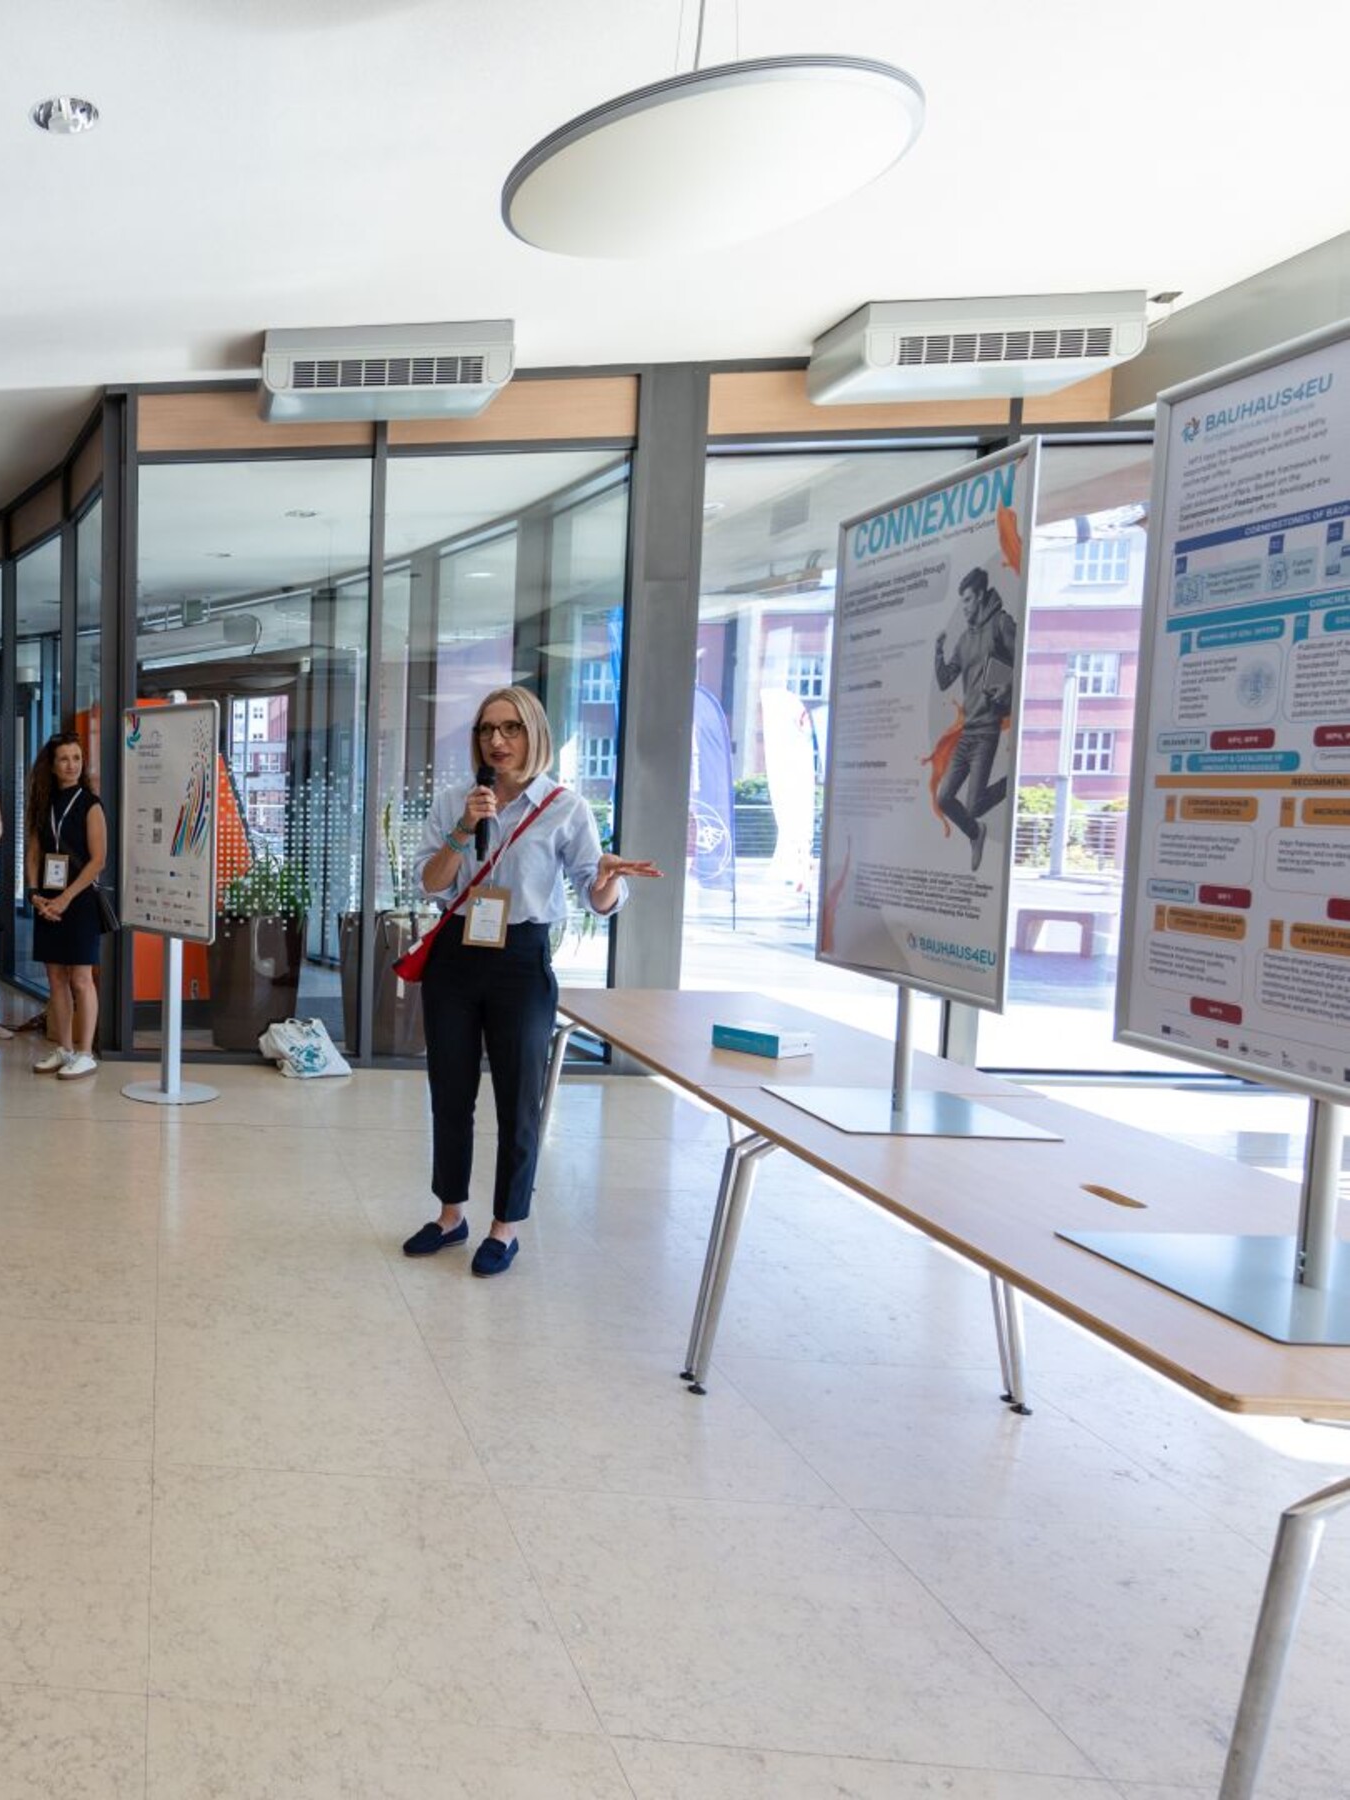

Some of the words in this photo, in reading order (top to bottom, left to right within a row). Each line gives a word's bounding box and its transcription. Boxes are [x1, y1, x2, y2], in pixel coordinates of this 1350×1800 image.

[1205, 373, 1333, 431] BAUHAUS4EU
[854, 463, 1016, 559] CONNEXION
[919, 936, 998, 967] BAUHAUS4EU
